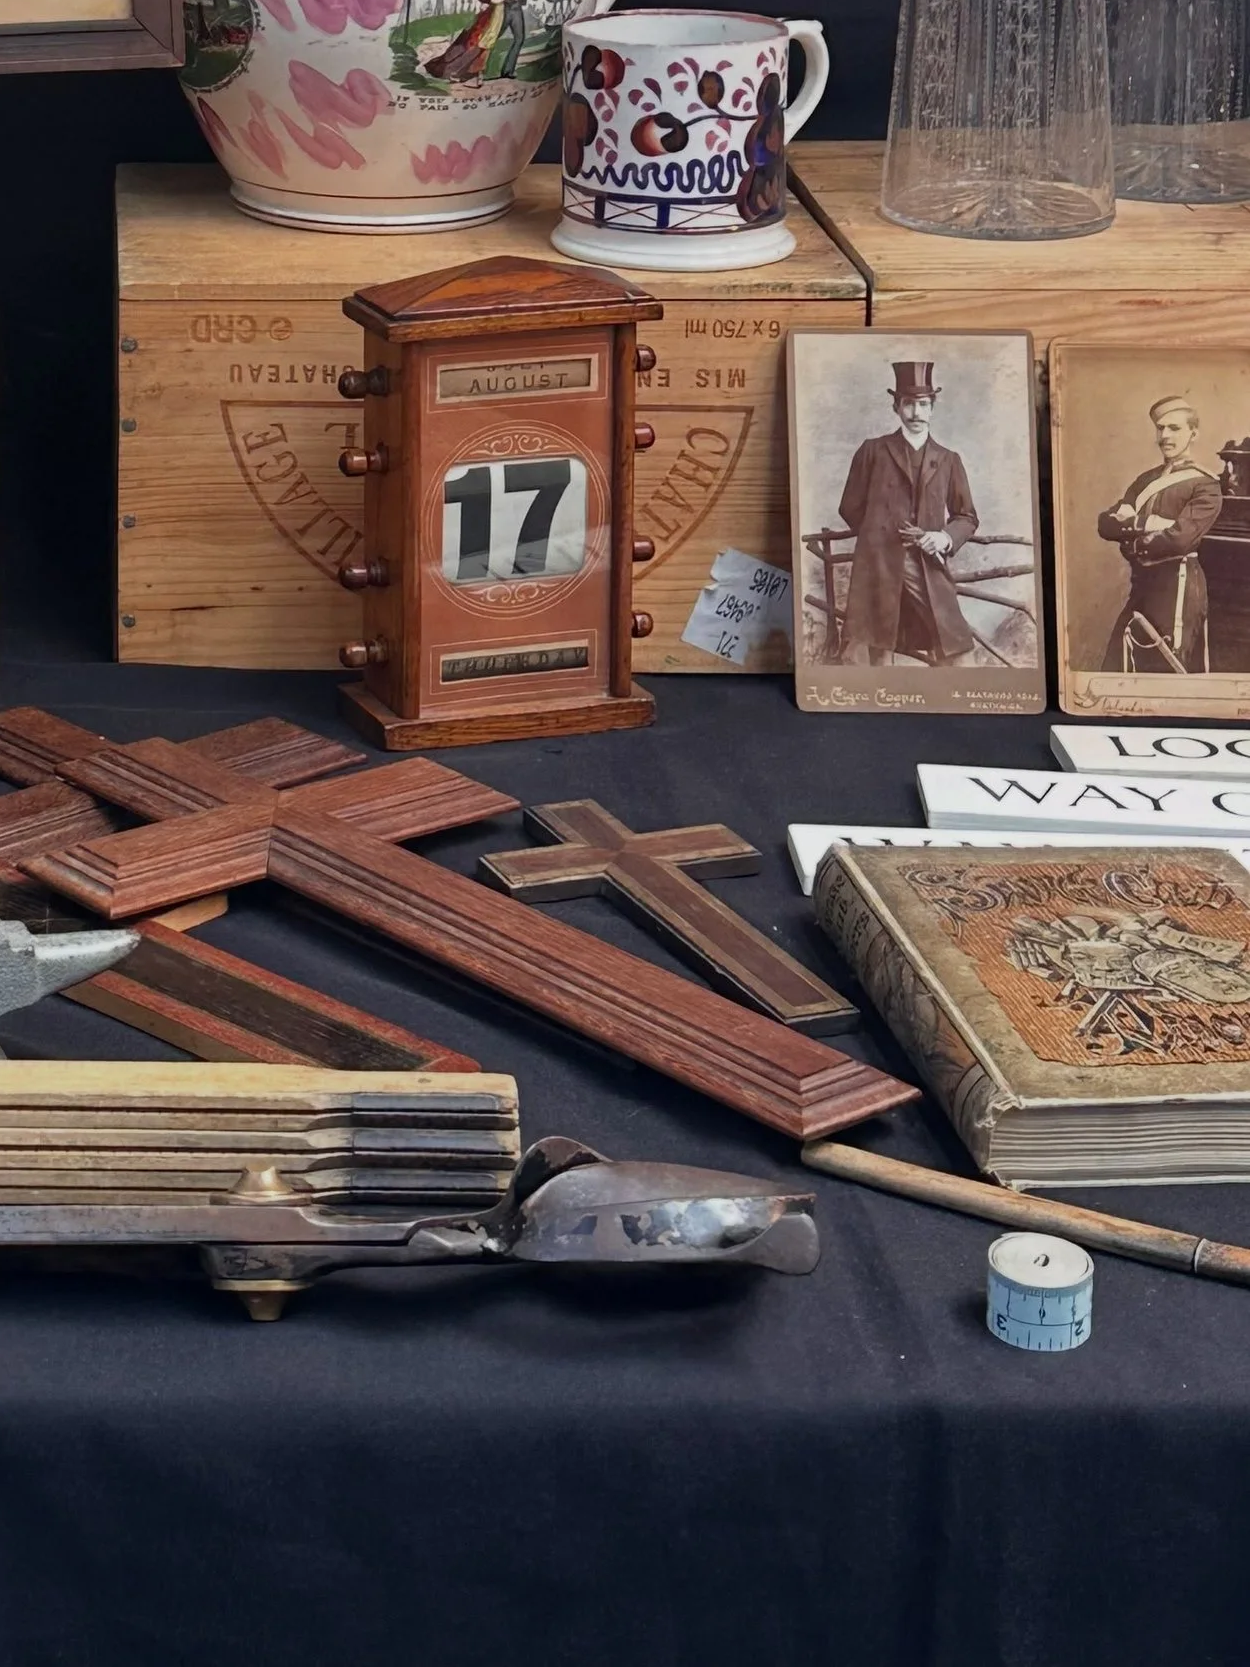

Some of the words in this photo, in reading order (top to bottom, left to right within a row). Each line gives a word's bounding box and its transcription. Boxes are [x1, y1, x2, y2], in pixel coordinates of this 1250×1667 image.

[189, 315, 257, 344] CRD
[685, 319, 707, 337] ml
[713, 319, 748, 338] 750
[768, 320, 781, 338] 6
[469, 372, 569, 394] AUGUST
[695, 367, 746, 388] MIS
[634, 426, 732, 546] CHAT
[444, 459, 571, 580] 17
[968, 777, 1178, 812] WAY
